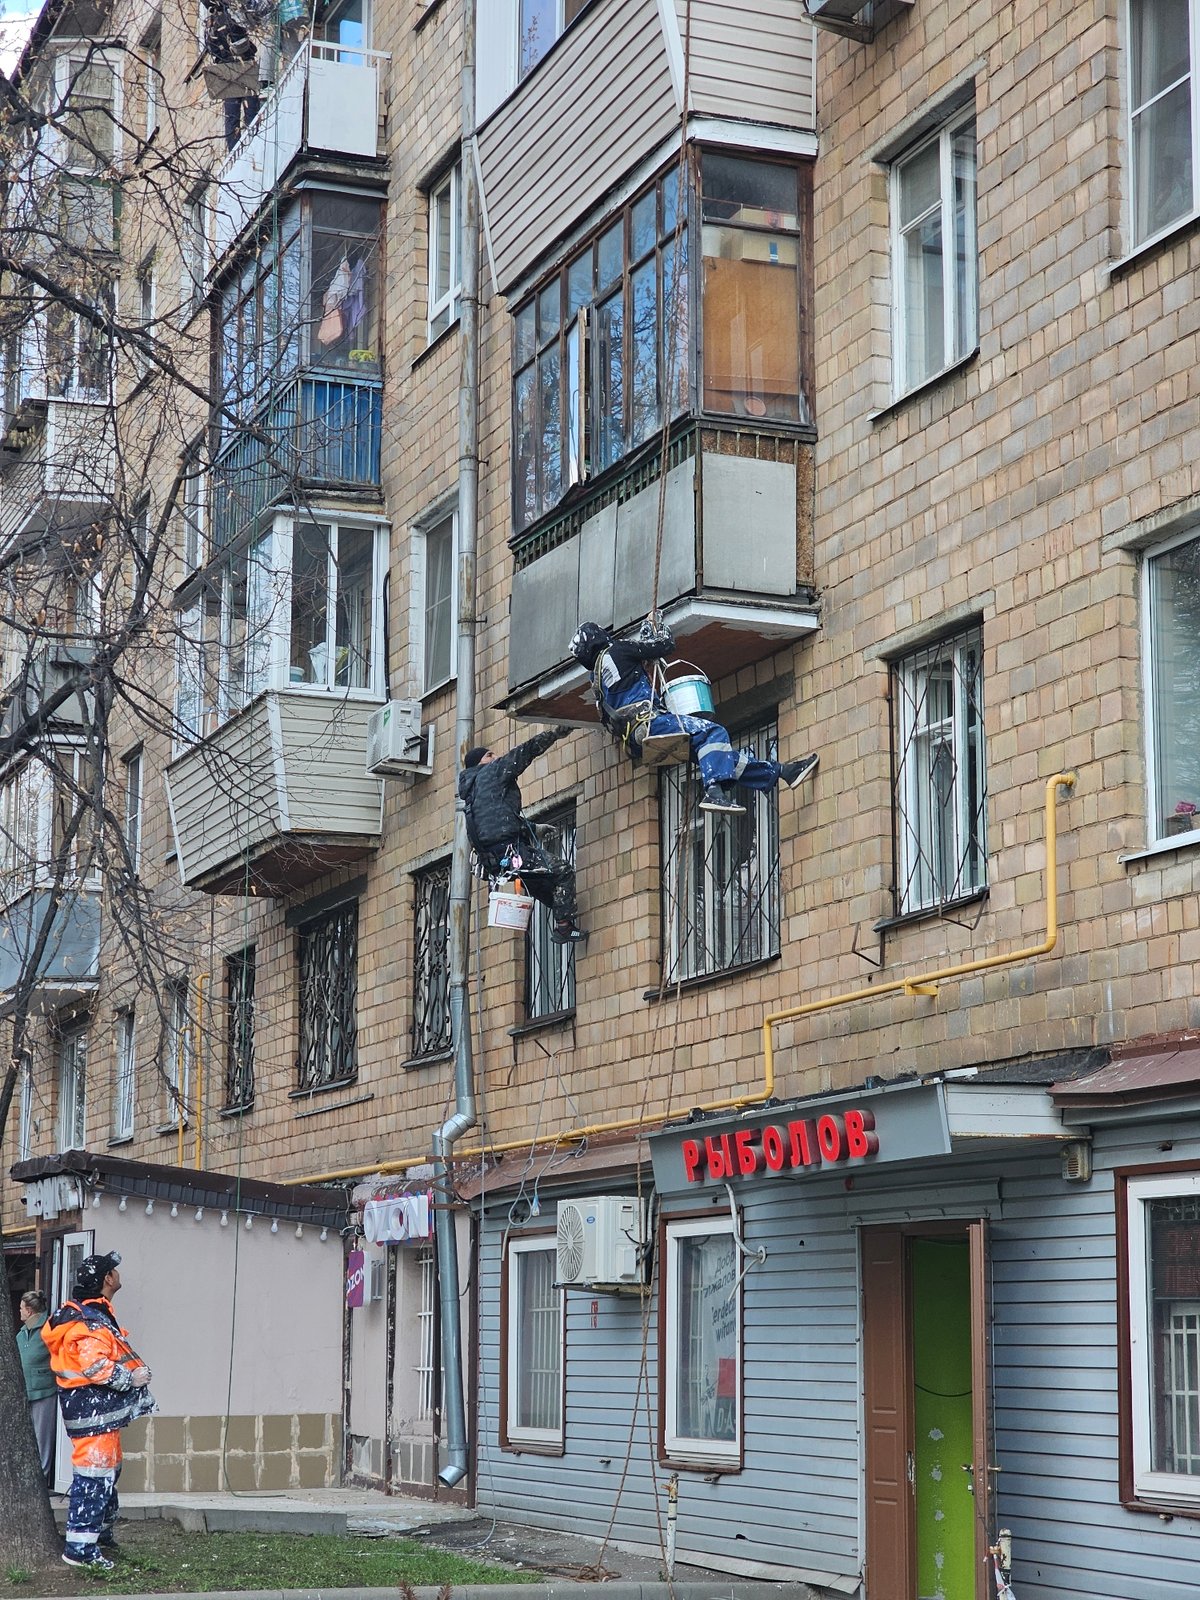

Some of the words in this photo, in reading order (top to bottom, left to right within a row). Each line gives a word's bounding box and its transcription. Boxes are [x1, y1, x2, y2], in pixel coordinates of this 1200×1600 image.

[682, 1109, 879, 1182] РЫБОЛОВ
[364, 1195, 429, 1243] OZON
[715, 1250, 736, 1278] Добр
